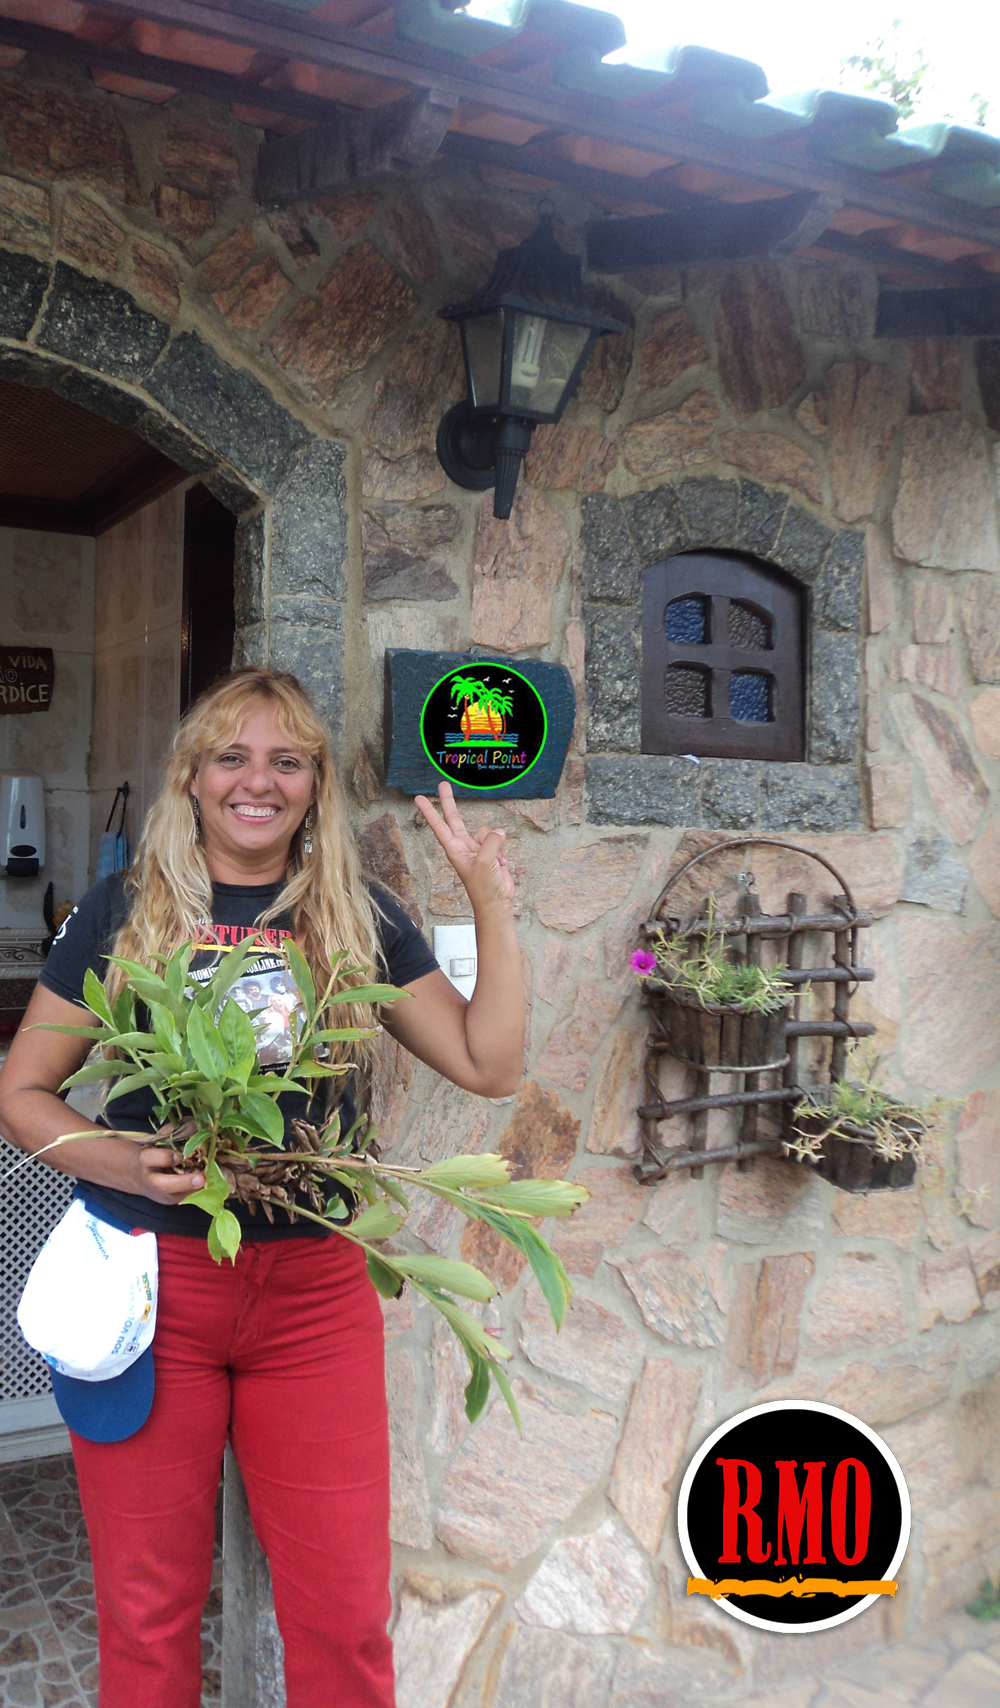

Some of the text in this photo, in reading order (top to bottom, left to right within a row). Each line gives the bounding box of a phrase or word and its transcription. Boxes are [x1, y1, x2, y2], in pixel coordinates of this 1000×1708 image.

[8, 653, 47, 671] VIDA
[436, 749, 527, 769] Tropical Point
[111, 1335, 125, 1355] SOU
